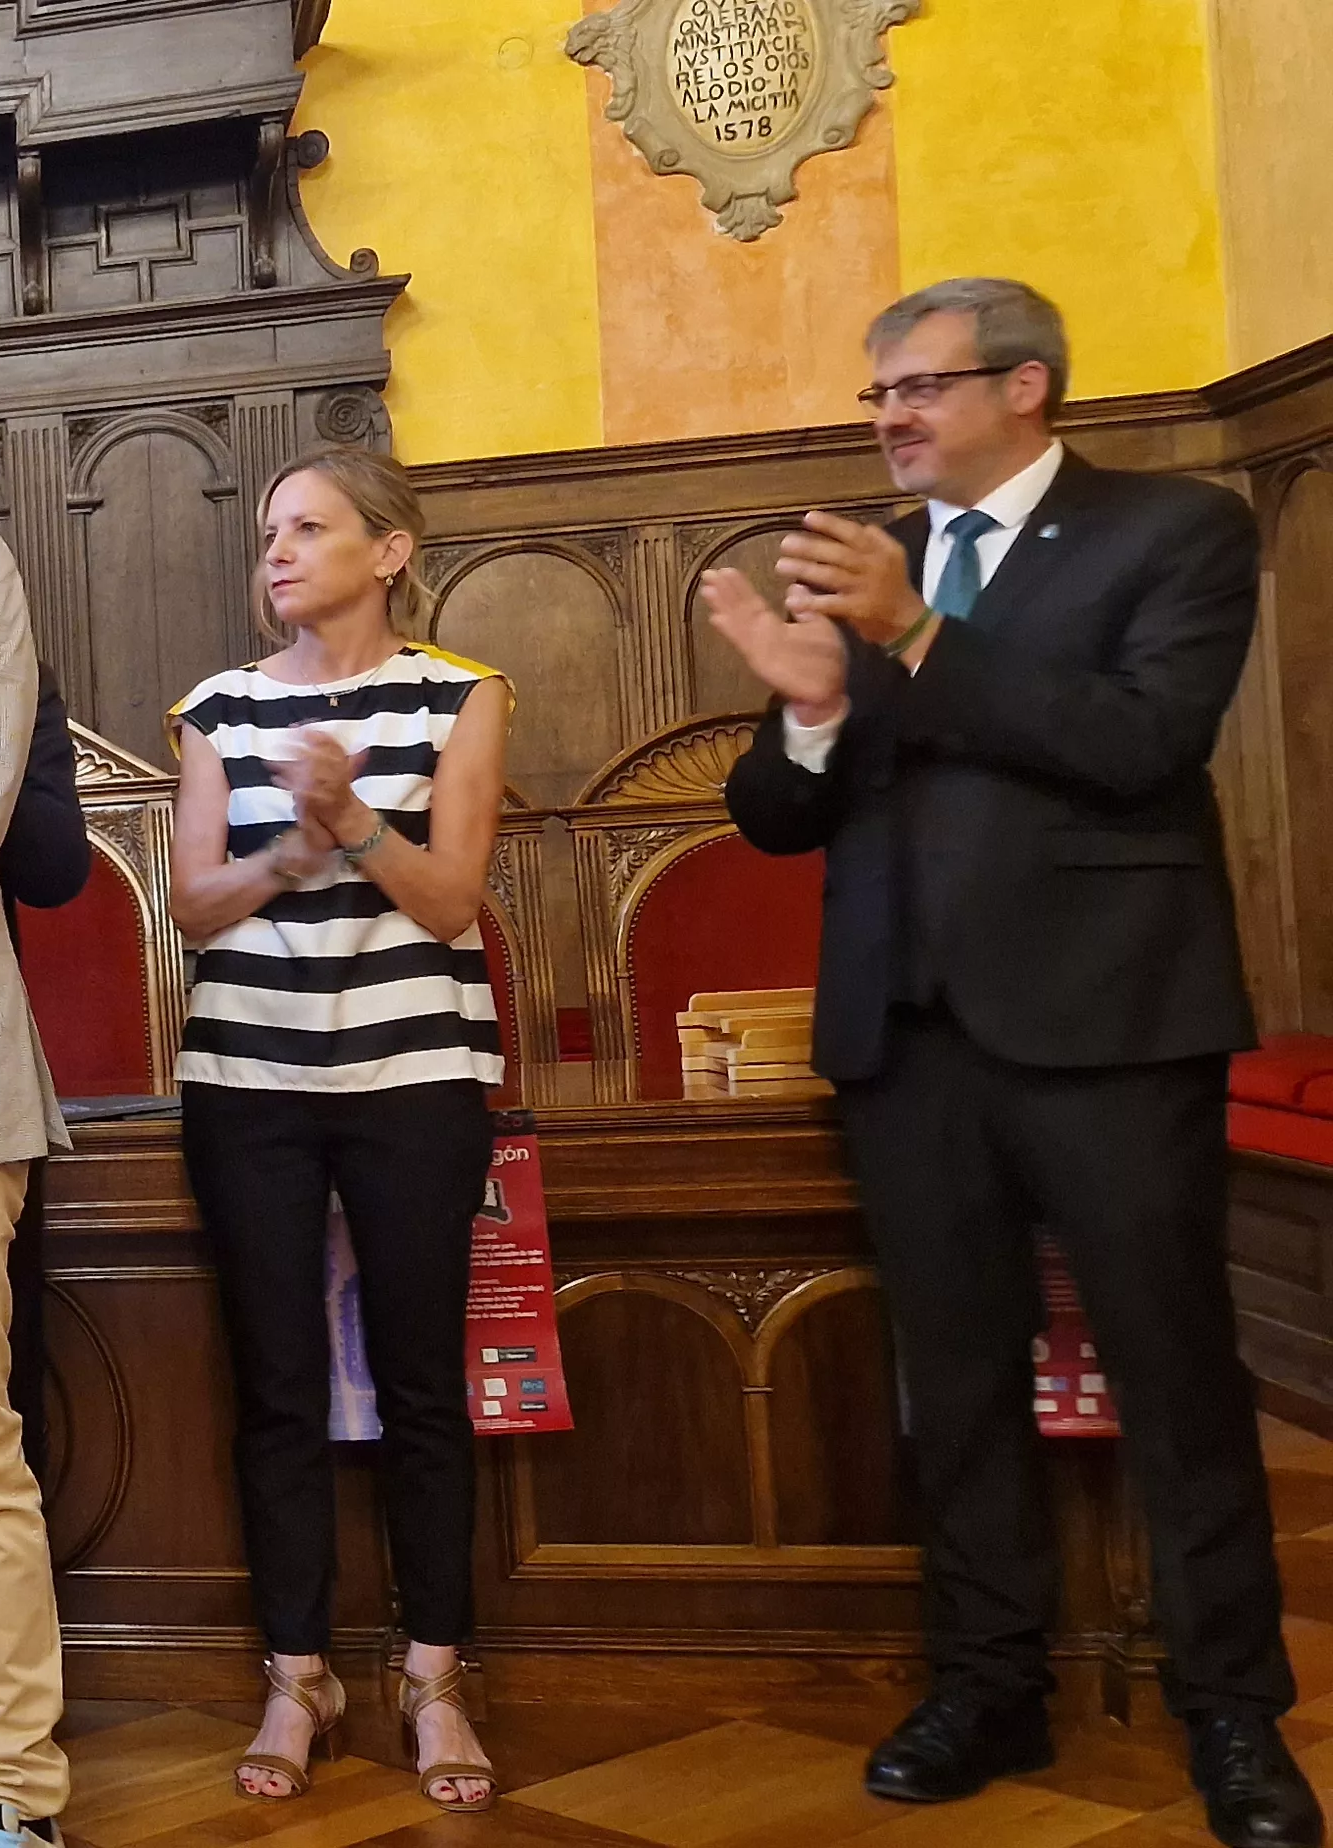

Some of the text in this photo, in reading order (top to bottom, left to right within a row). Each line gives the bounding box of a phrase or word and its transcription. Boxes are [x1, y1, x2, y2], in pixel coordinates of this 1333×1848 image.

[676, 58, 754, 89] RELOS
[693, 103, 719, 123] LA
[715, 116, 772, 142] 1578
[491, 1145, 530, 1166] gón
